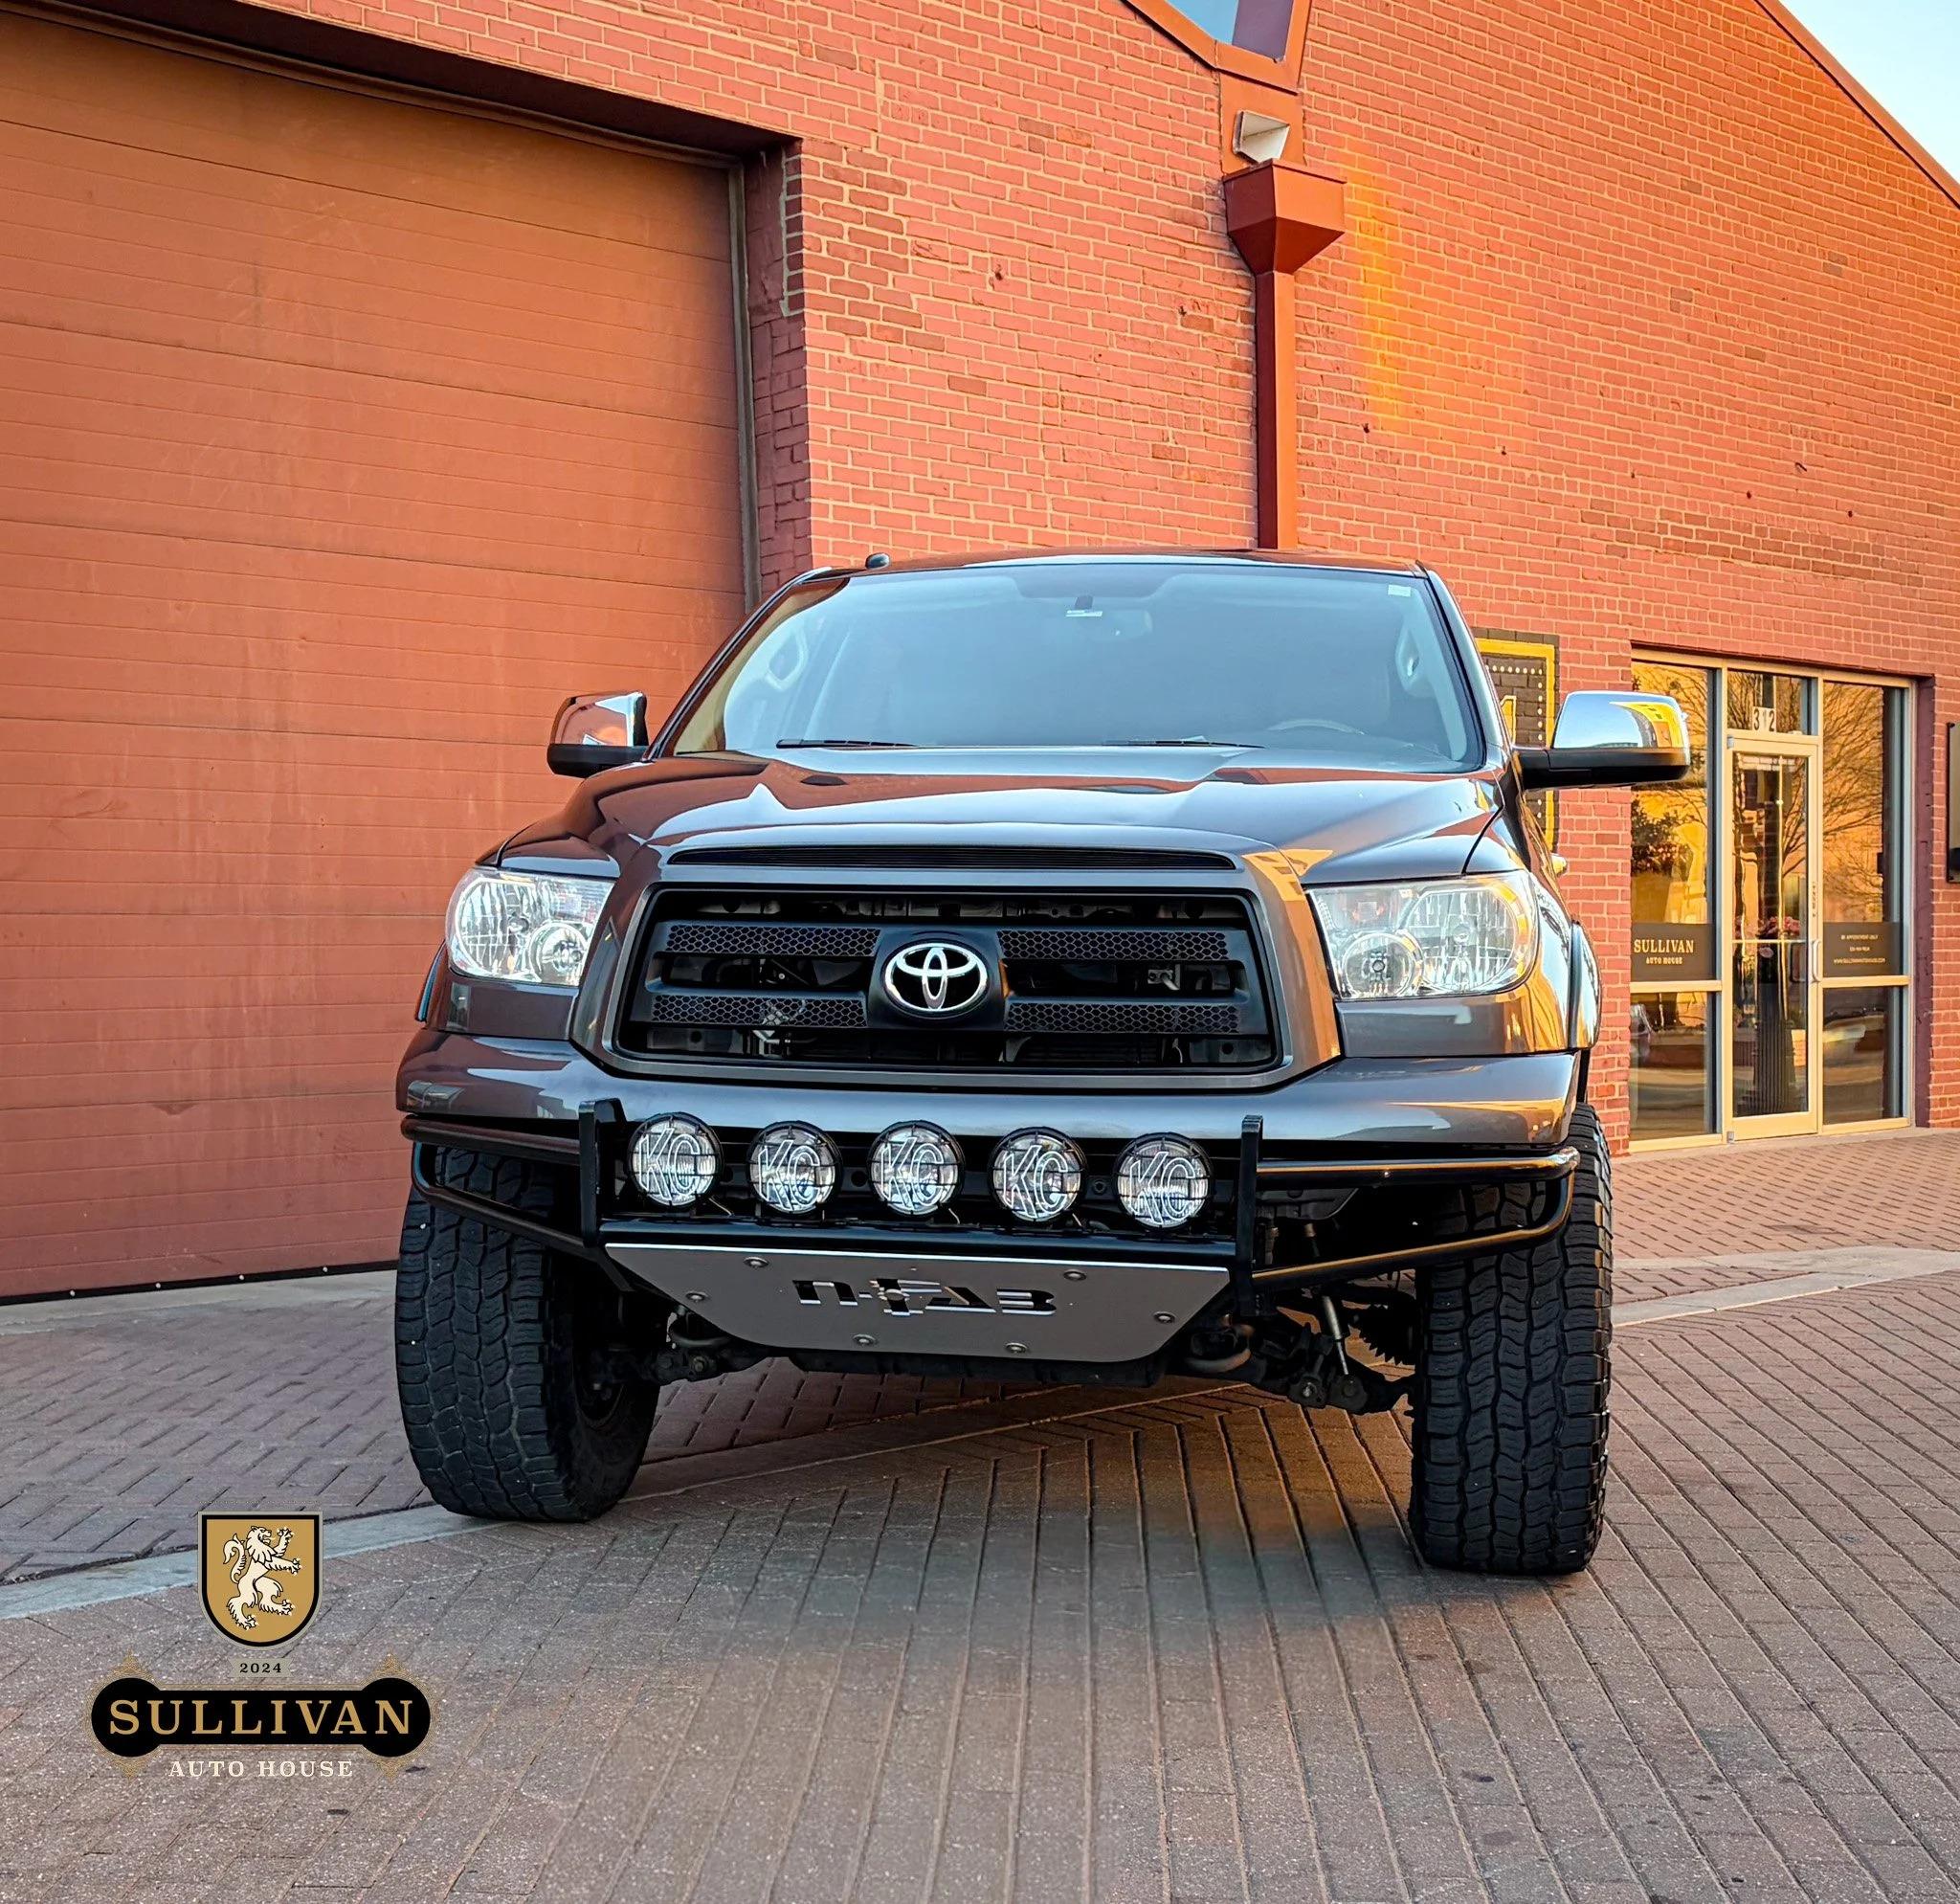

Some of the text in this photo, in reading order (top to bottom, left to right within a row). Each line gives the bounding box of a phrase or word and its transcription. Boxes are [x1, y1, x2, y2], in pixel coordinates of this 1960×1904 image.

[1753, 708, 1775, 732] 312
[1634, 939, 1694, 953] SULLIVAN
[638, 1128, 701, 1201] KC
[758, 1139, 820, 1212] KC
[880, 1136, 944, 1210] KC
[1004, 1145, 1068, 1219] KC
[1129, 1151, 1195, 1224] KC
